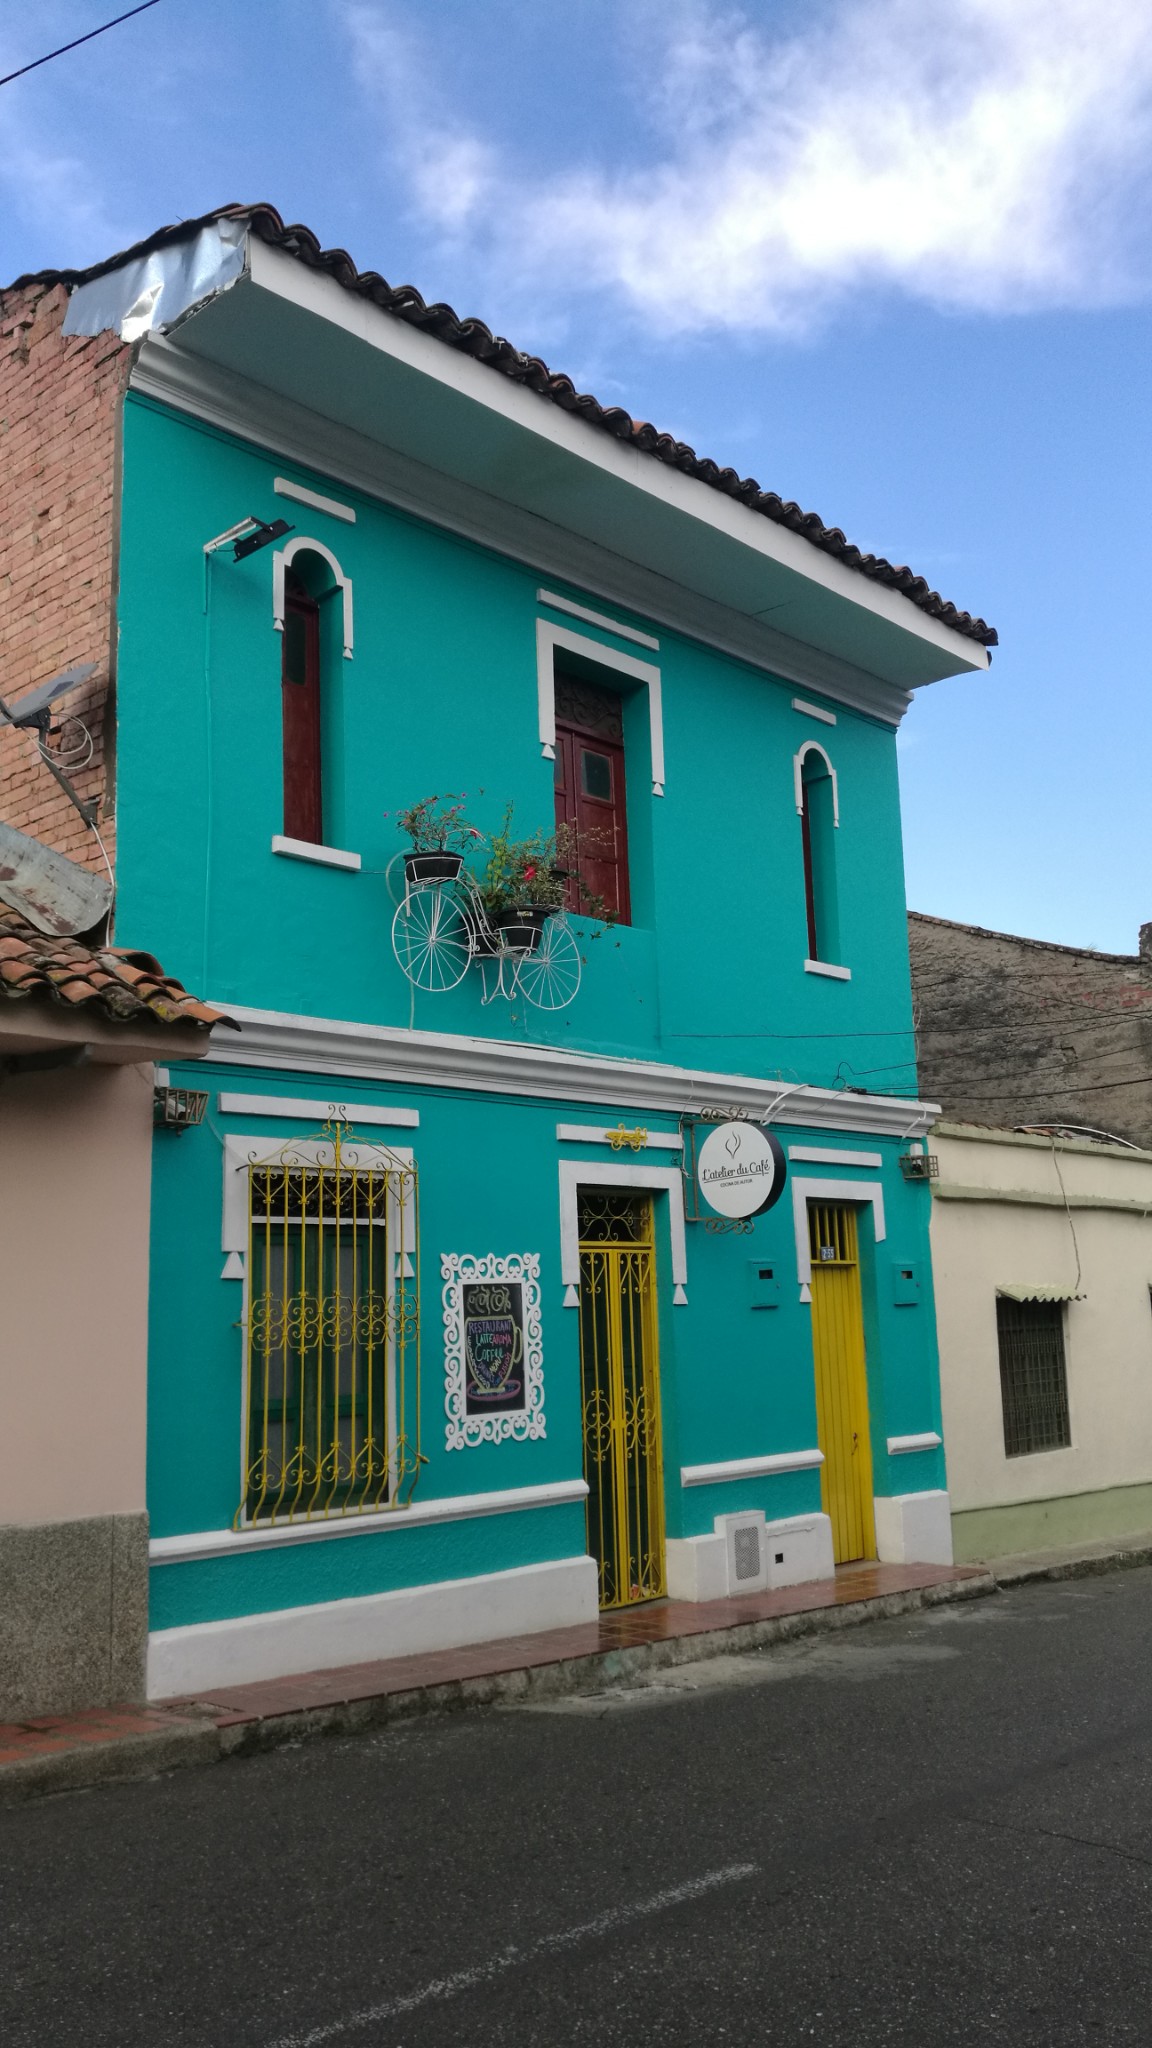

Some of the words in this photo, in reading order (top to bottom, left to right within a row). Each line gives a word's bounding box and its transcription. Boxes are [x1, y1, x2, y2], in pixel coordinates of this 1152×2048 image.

[702, 1166, 735, 1181] L'atelier
[737, 1163, 749, 1175] du
[750, 1159, 771, 1176] Café
[468, 1320, 511, 1335] RESTAURANT
[476, 1334, 493, 1344] LATTE
[492, 1333, 512, 1346] AROMA
